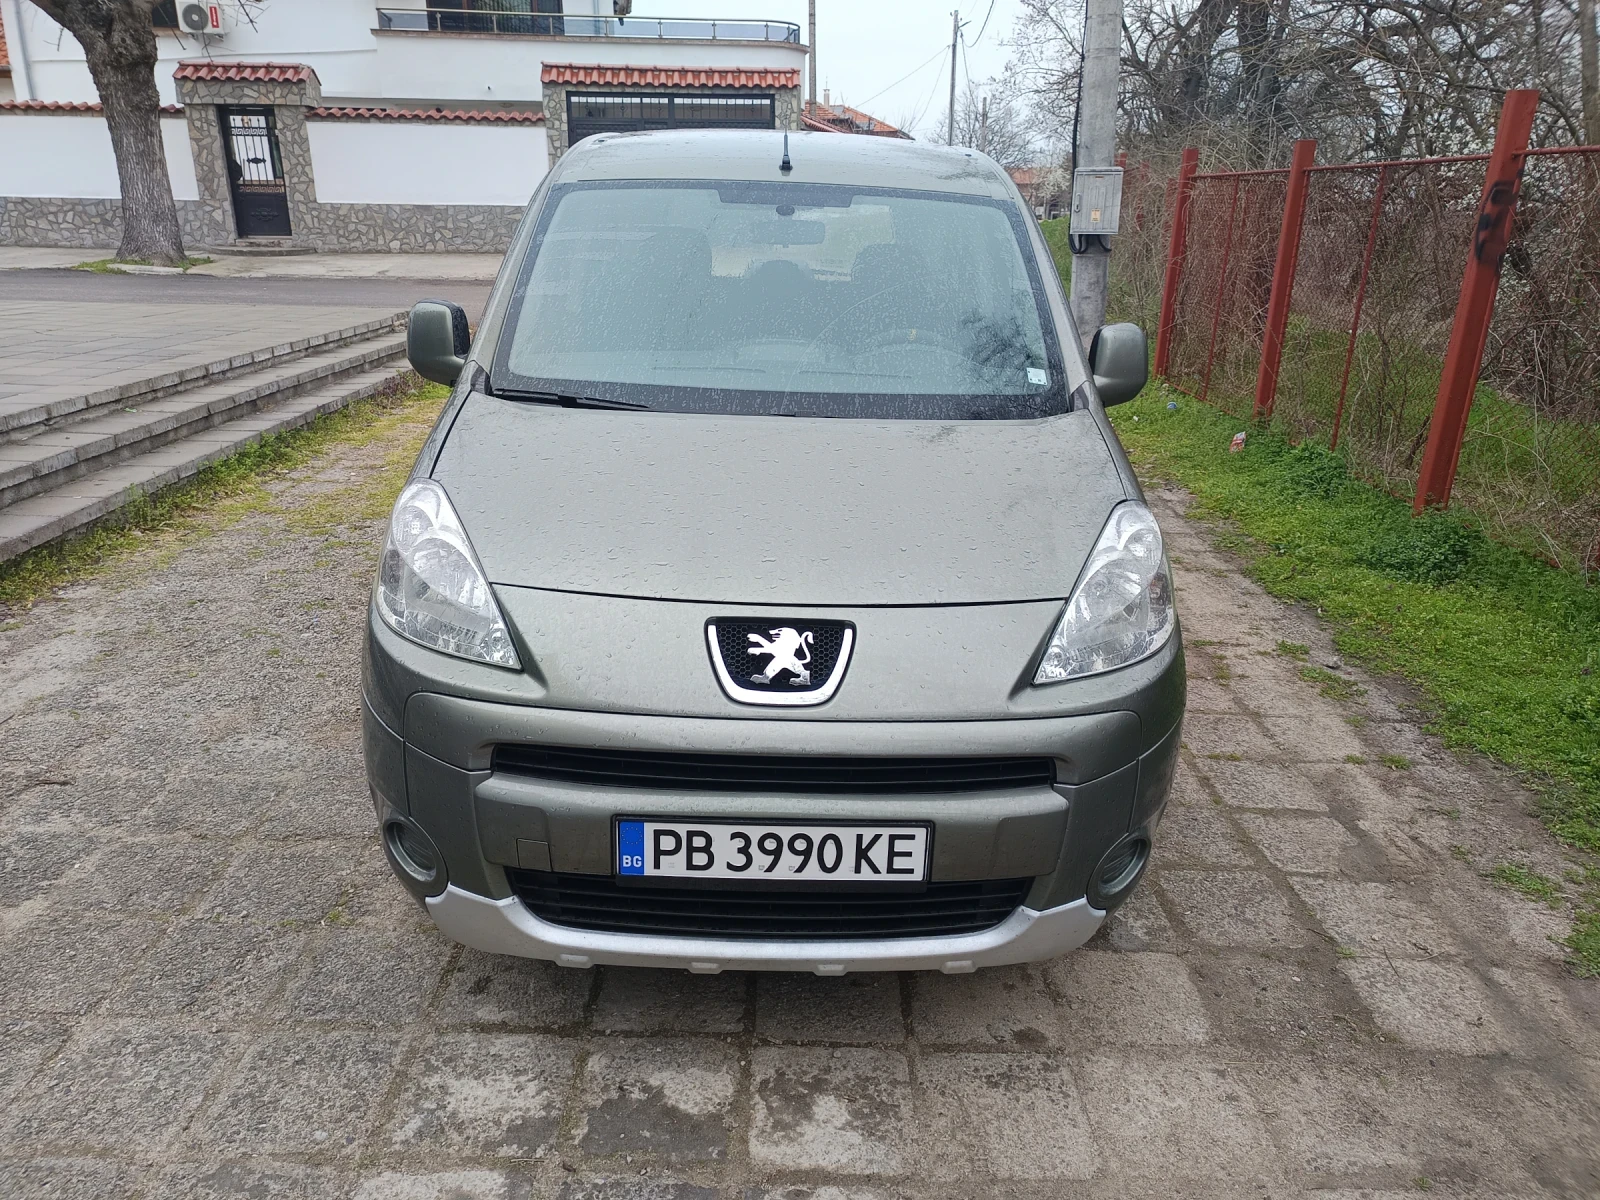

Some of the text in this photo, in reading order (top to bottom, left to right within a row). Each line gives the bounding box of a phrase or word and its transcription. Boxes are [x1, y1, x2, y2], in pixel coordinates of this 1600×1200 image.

[622, 855, 642, 868] BG
[653, 828, 916, 875] PB 3990 KE
